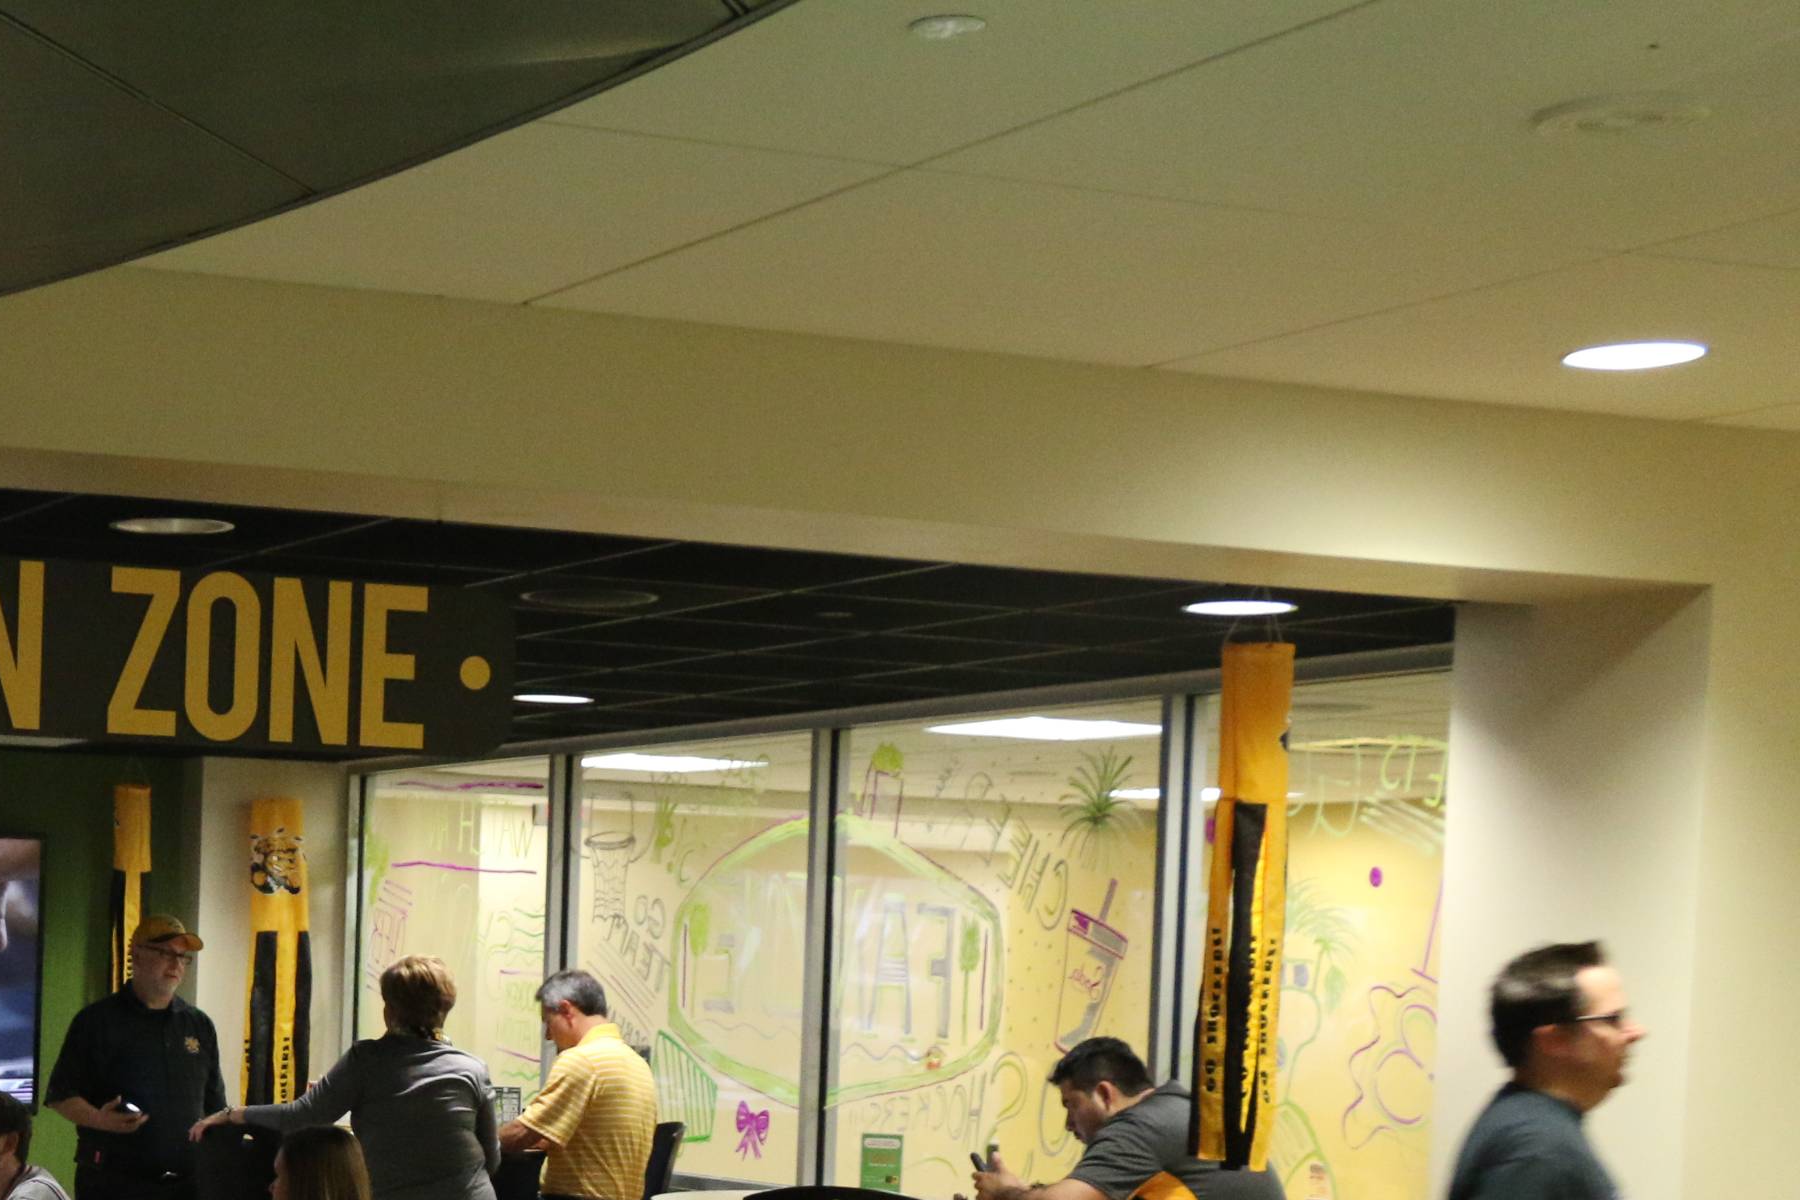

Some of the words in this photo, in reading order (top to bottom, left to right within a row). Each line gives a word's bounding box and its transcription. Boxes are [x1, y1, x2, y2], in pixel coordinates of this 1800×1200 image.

[107, 566, 429, 751] ZONE
[1206, 927, 1223, 1045] SHOCKERS!
[280, 1037, 290, 1104] OCKERS!
[1204, 1059, 1217, 1093] GO
